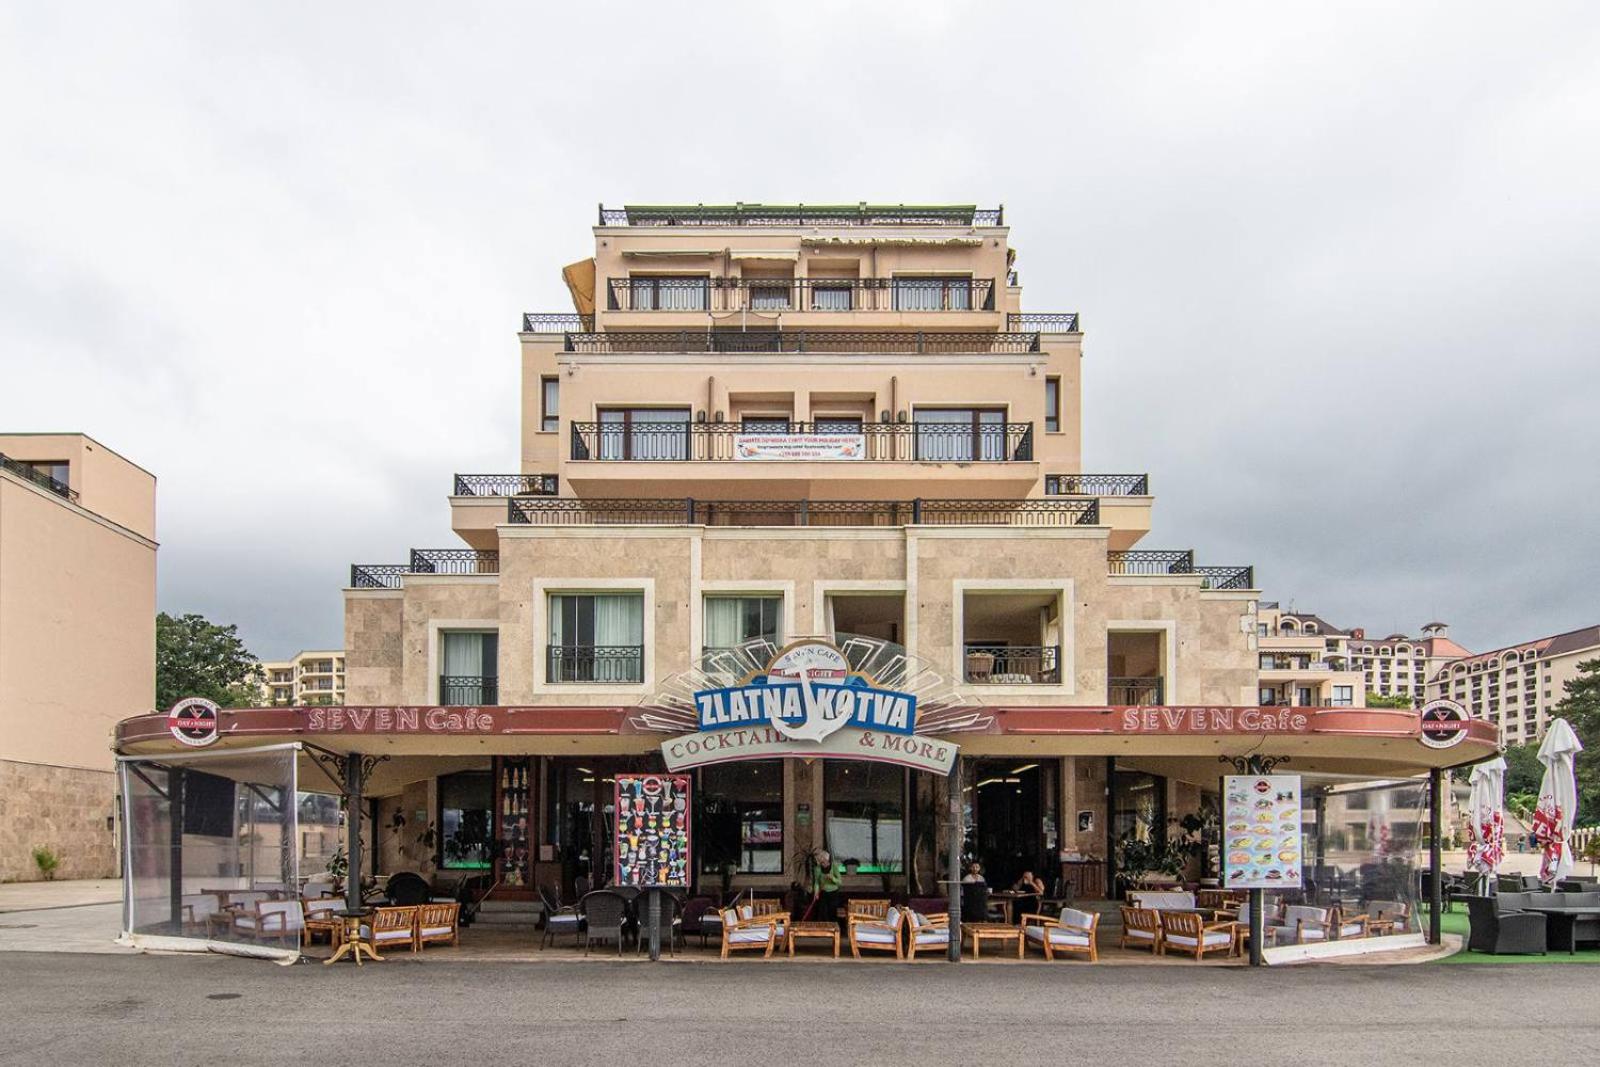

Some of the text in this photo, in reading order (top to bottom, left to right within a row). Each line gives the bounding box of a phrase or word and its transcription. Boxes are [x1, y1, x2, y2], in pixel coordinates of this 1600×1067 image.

[309, 708, 494, 731] SEVEN Cafe
[699, 687, 908, 729] ZLATNA KOTVA
[1124, 708, 1308, 731] SEVEN Cafe
[859, 728, 875, 746] &
[882, 736, 948, 763] MORE
